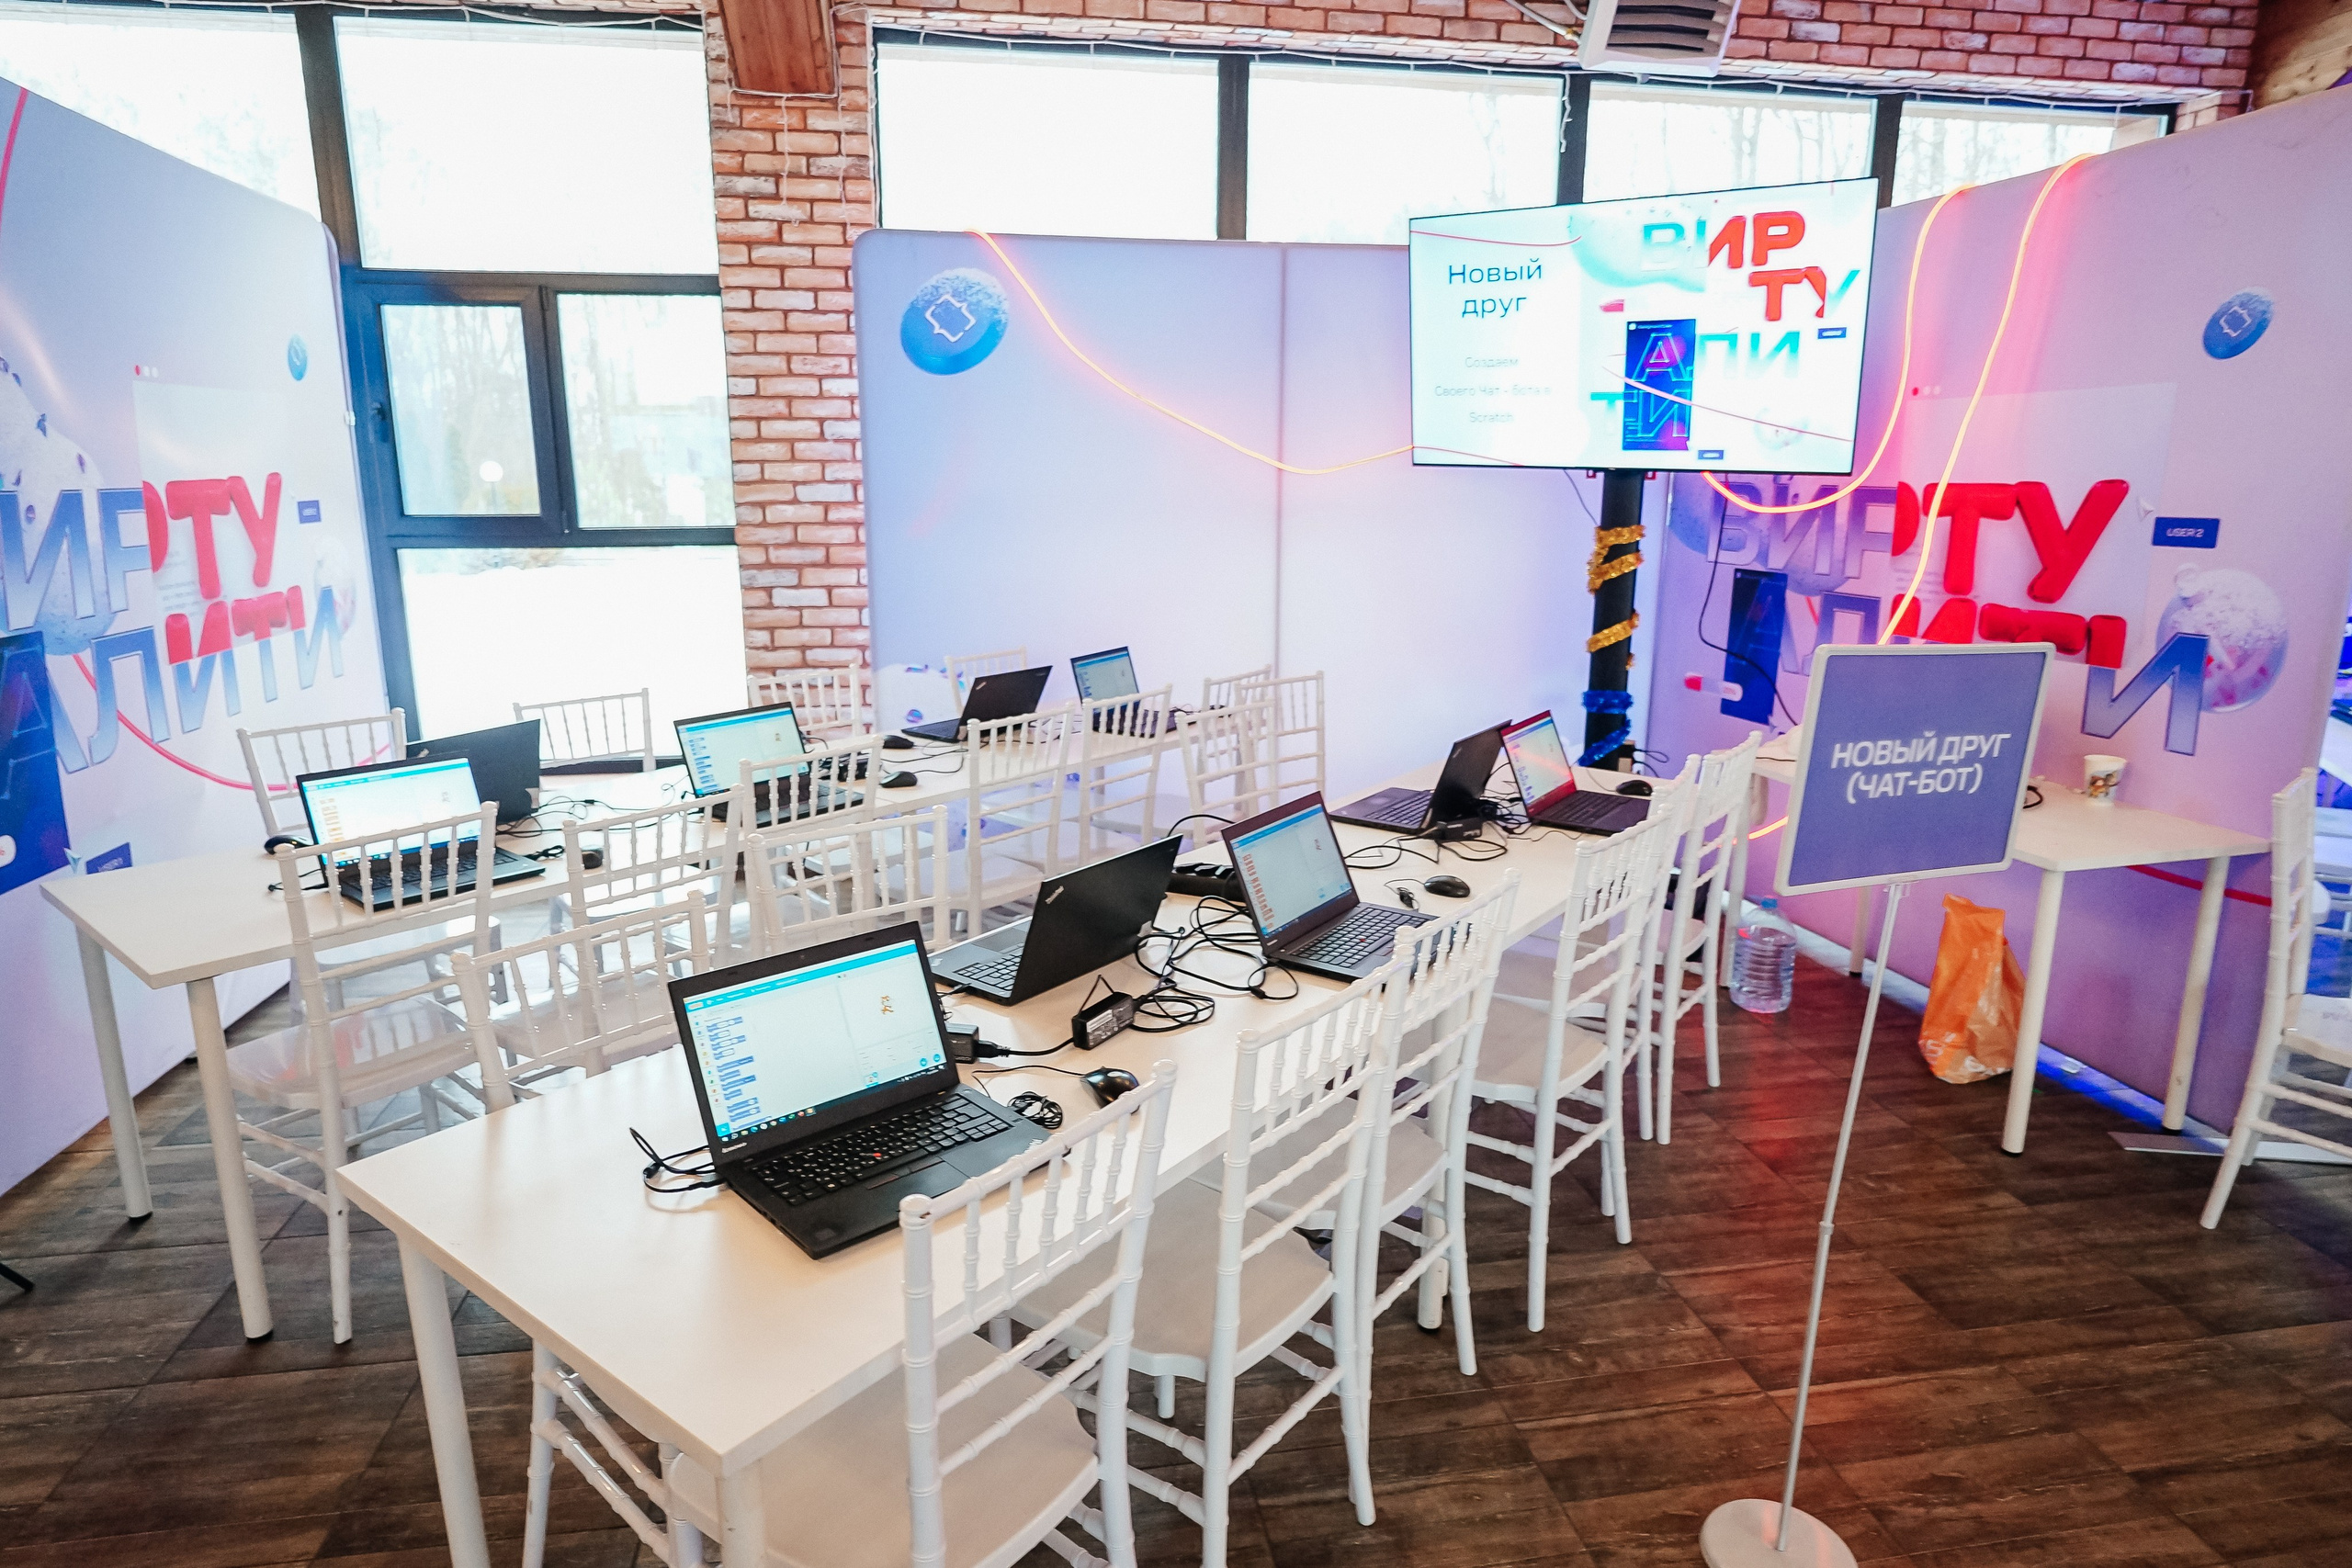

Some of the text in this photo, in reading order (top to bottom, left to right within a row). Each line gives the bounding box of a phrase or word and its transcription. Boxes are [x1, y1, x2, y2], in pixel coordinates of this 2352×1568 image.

[1448, 258, 1542, 285] Новый
[1462, 297, 1527, 319] друг
[1748, 265, 1860, 321] ТУ
[1706, 479, 2130, 604] ВИРТУ
[2165, 527, 2205, 538] USER 2
[1830, 730, 2012, 769] НОВЫЙ ДРУГ
[1846, 762, 1984, 805] (ЧАТ-БОТ)
